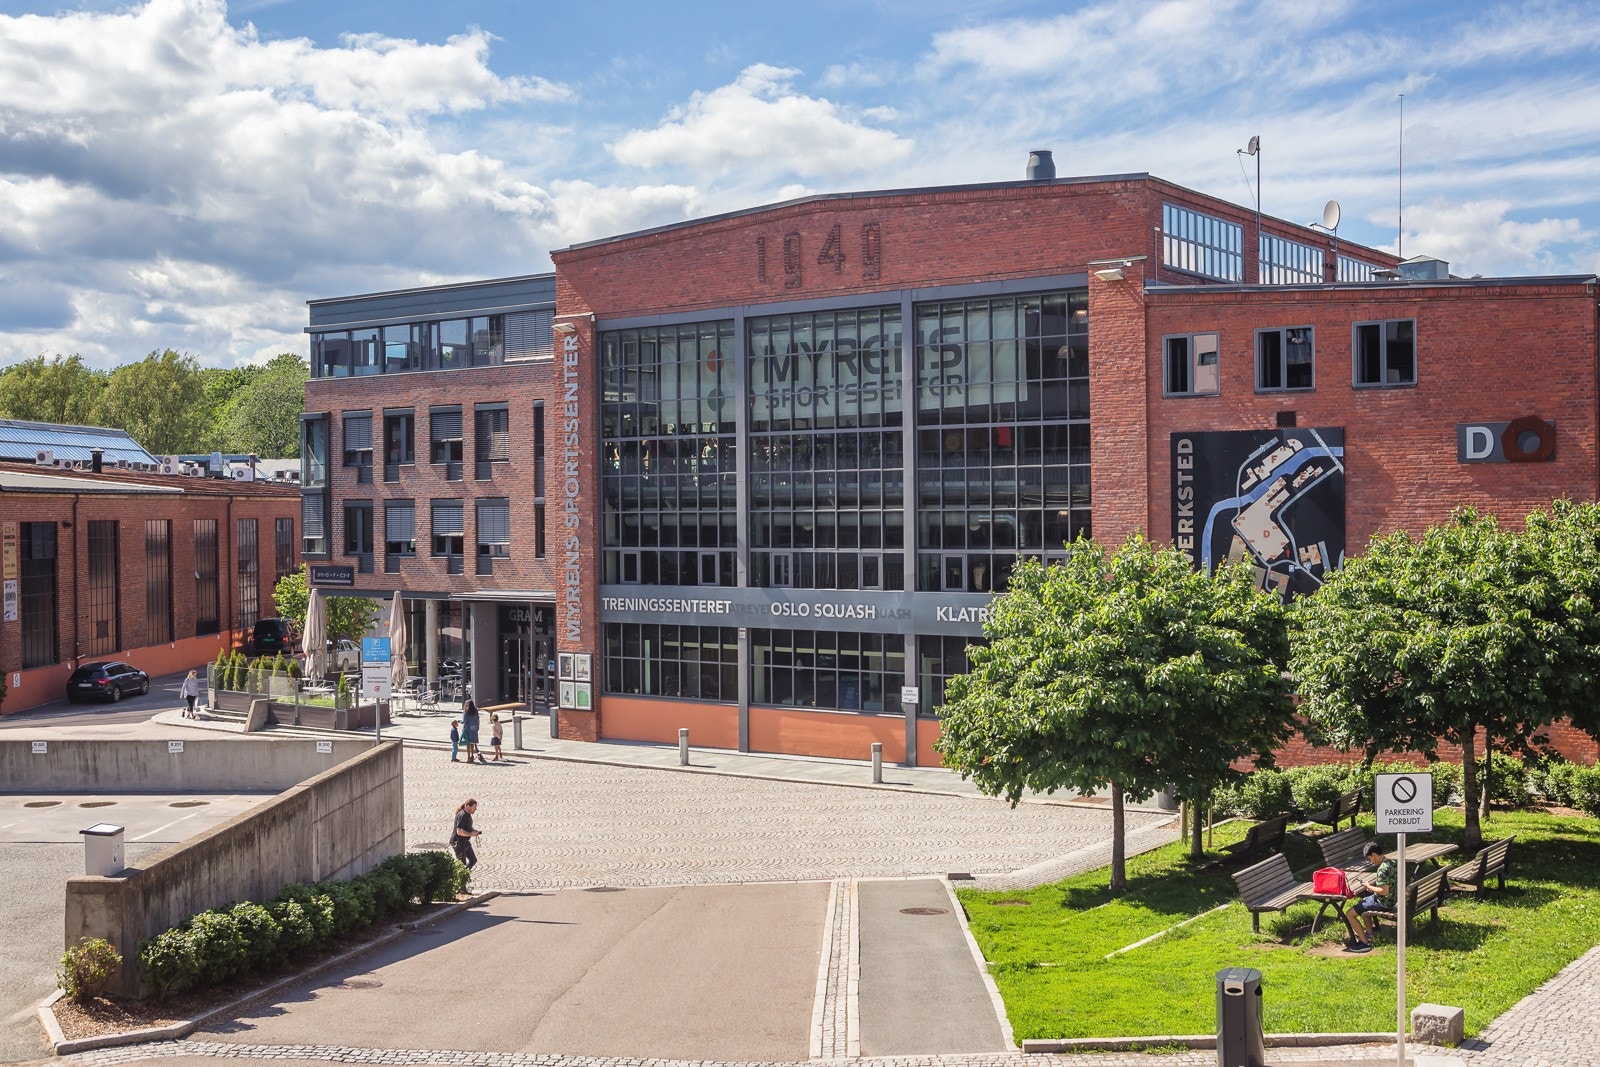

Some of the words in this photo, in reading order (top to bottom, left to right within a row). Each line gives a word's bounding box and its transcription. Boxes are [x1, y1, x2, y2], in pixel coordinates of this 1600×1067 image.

[564, 335, 579, 528] SPORTSSENTER
[1466, 426, 1494, 459] D
[565, 535, 581, 642] MYRENS
[510, 610, 543, 622] GRAM
[602, 597, 732, 614] TRENINGSSENTERET
[770, 602, 810, 617] OSLO
[814, 603, 876, 619] SQUASH
[936, 606, 994, 624] KLATR
